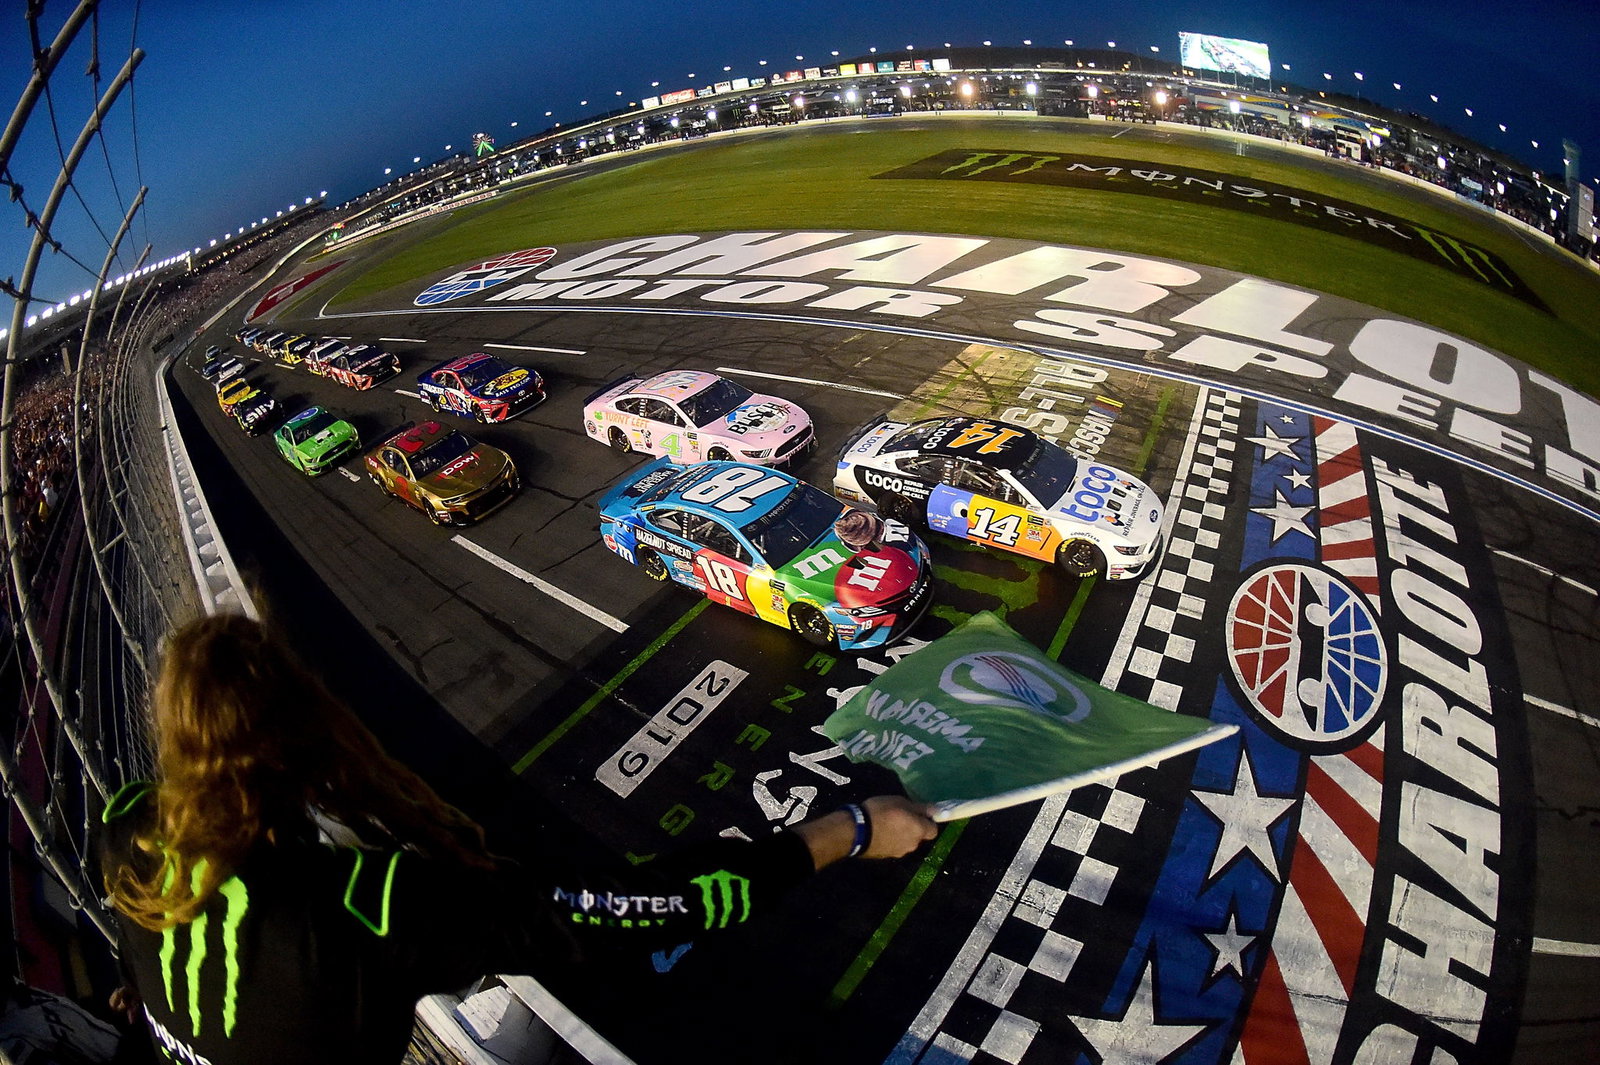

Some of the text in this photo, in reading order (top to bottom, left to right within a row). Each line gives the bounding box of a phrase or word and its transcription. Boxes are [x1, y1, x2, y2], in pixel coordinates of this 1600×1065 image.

[1066, 162, 1412, 240] MONSTER
[485, 279, 964, 318] MOTOR
[246, 400, 274, 423] ally
[604, 411, 650, 428] TURNT LEFT
[728, 402, 780, 435] BUSCH
[659, 433, 682, 457] 4
[857, 436, 882, 453] toco
[923, 427, 954, 450] toco
[443, 455, 475, 477] DOW
[865, 469, 903, 494] toco
[902, 485, 930, 495] COVERAGE
[903, 479, 924, 489] REPAIR
[1060, 466, 1117, 523] toco
[967, 506, 1022, 547] 14
[635, 528, 667, 549] HAZELNUT
[665, 540, 694, 560] SPREAD
[696, 553, 746, 602] 18
[792, 548, 848, 580] m
[847, 555, 893, 593] m
[902, 580, 929, 613] CAMRY
[860, 619, 874, 632] 18
[615, 669, 730, 780] 2019
[553, 887, 690, 918] MONSTER
[571, 912, 667, 930] ENERGY
